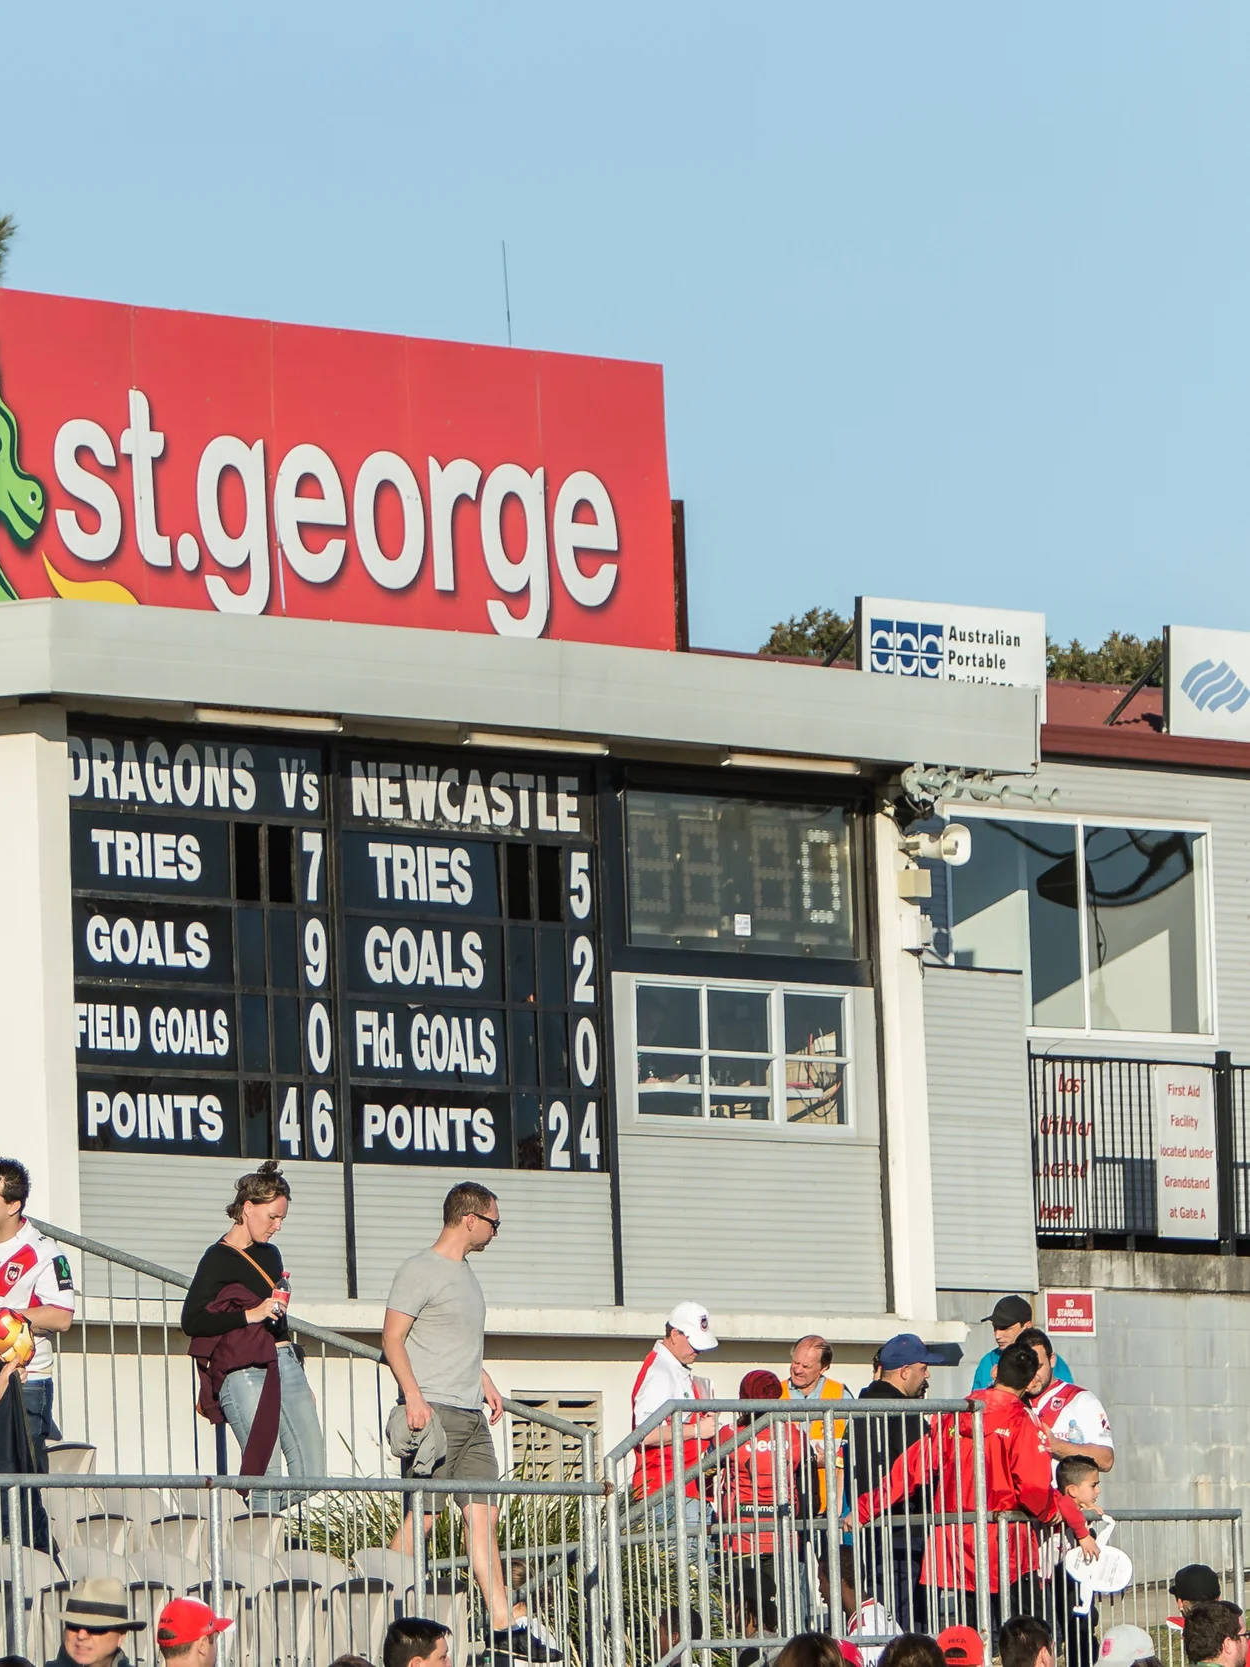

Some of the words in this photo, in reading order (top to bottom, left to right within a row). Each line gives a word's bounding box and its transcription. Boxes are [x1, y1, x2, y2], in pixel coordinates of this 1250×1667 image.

[53, 387, 619, 639] st.george
[949, 626, 1021, 647] Australian
[949, 650, 1006, 670] Portable
[68, 736, 257, 811] DRAGONS
[351, 761, 581, 832] NEWCASTLE
[91, 828, 202, 882] TRIES
[302, 831, 323, 901] 7
[368, 842, 473, 906] TRIES
[569, 852, 592, 919] 5
[86, 915, 211, 969] GOALS
[304, 917, 327, 987] 9
[364, 925, 484, 989] GOALS
[572, 935, 595, 1003] 2
[74, 1002, 141, 1052] FIELD
[150, 1006, 229, 1056] GOALS
[308, 1002, 331, 1074] 0
[355, 1010, 403, 1069] Fld.
[410, 1013, 496, 1076] GOALS
[575, 1017, 598, 1087] 0
[87, 1090, 224, 1142] POINTS
[279, 1086, 335, 1158] 46
[1168, 1084, 1185, 1097] First
[1188, 1085, 1200, 1097] Aid
[1170, 1115, 1199, 1131] Facility
[363, 1104, 496, 1153] POINTS
[548, 1101, 600, 1169] 24
[1160, 1144, 1187, 1158] located
[1189, 1147, 1214, 1159] under
[1034, 1160, 1089, 1179] ocated
[1164, 1175, 1210, 1190] Grandstand
[1170, 1207, 1178, 1218] at
[1180, 1206, 1198, 1219] Gate
[1200, 1208, 1207, 1219] A
[1048, 1317, 1067, 1327] ALONG
[1067, 1317, 1093, 1327] PATHWAY
[1056, 1308, 1084, 1318] STANDING
